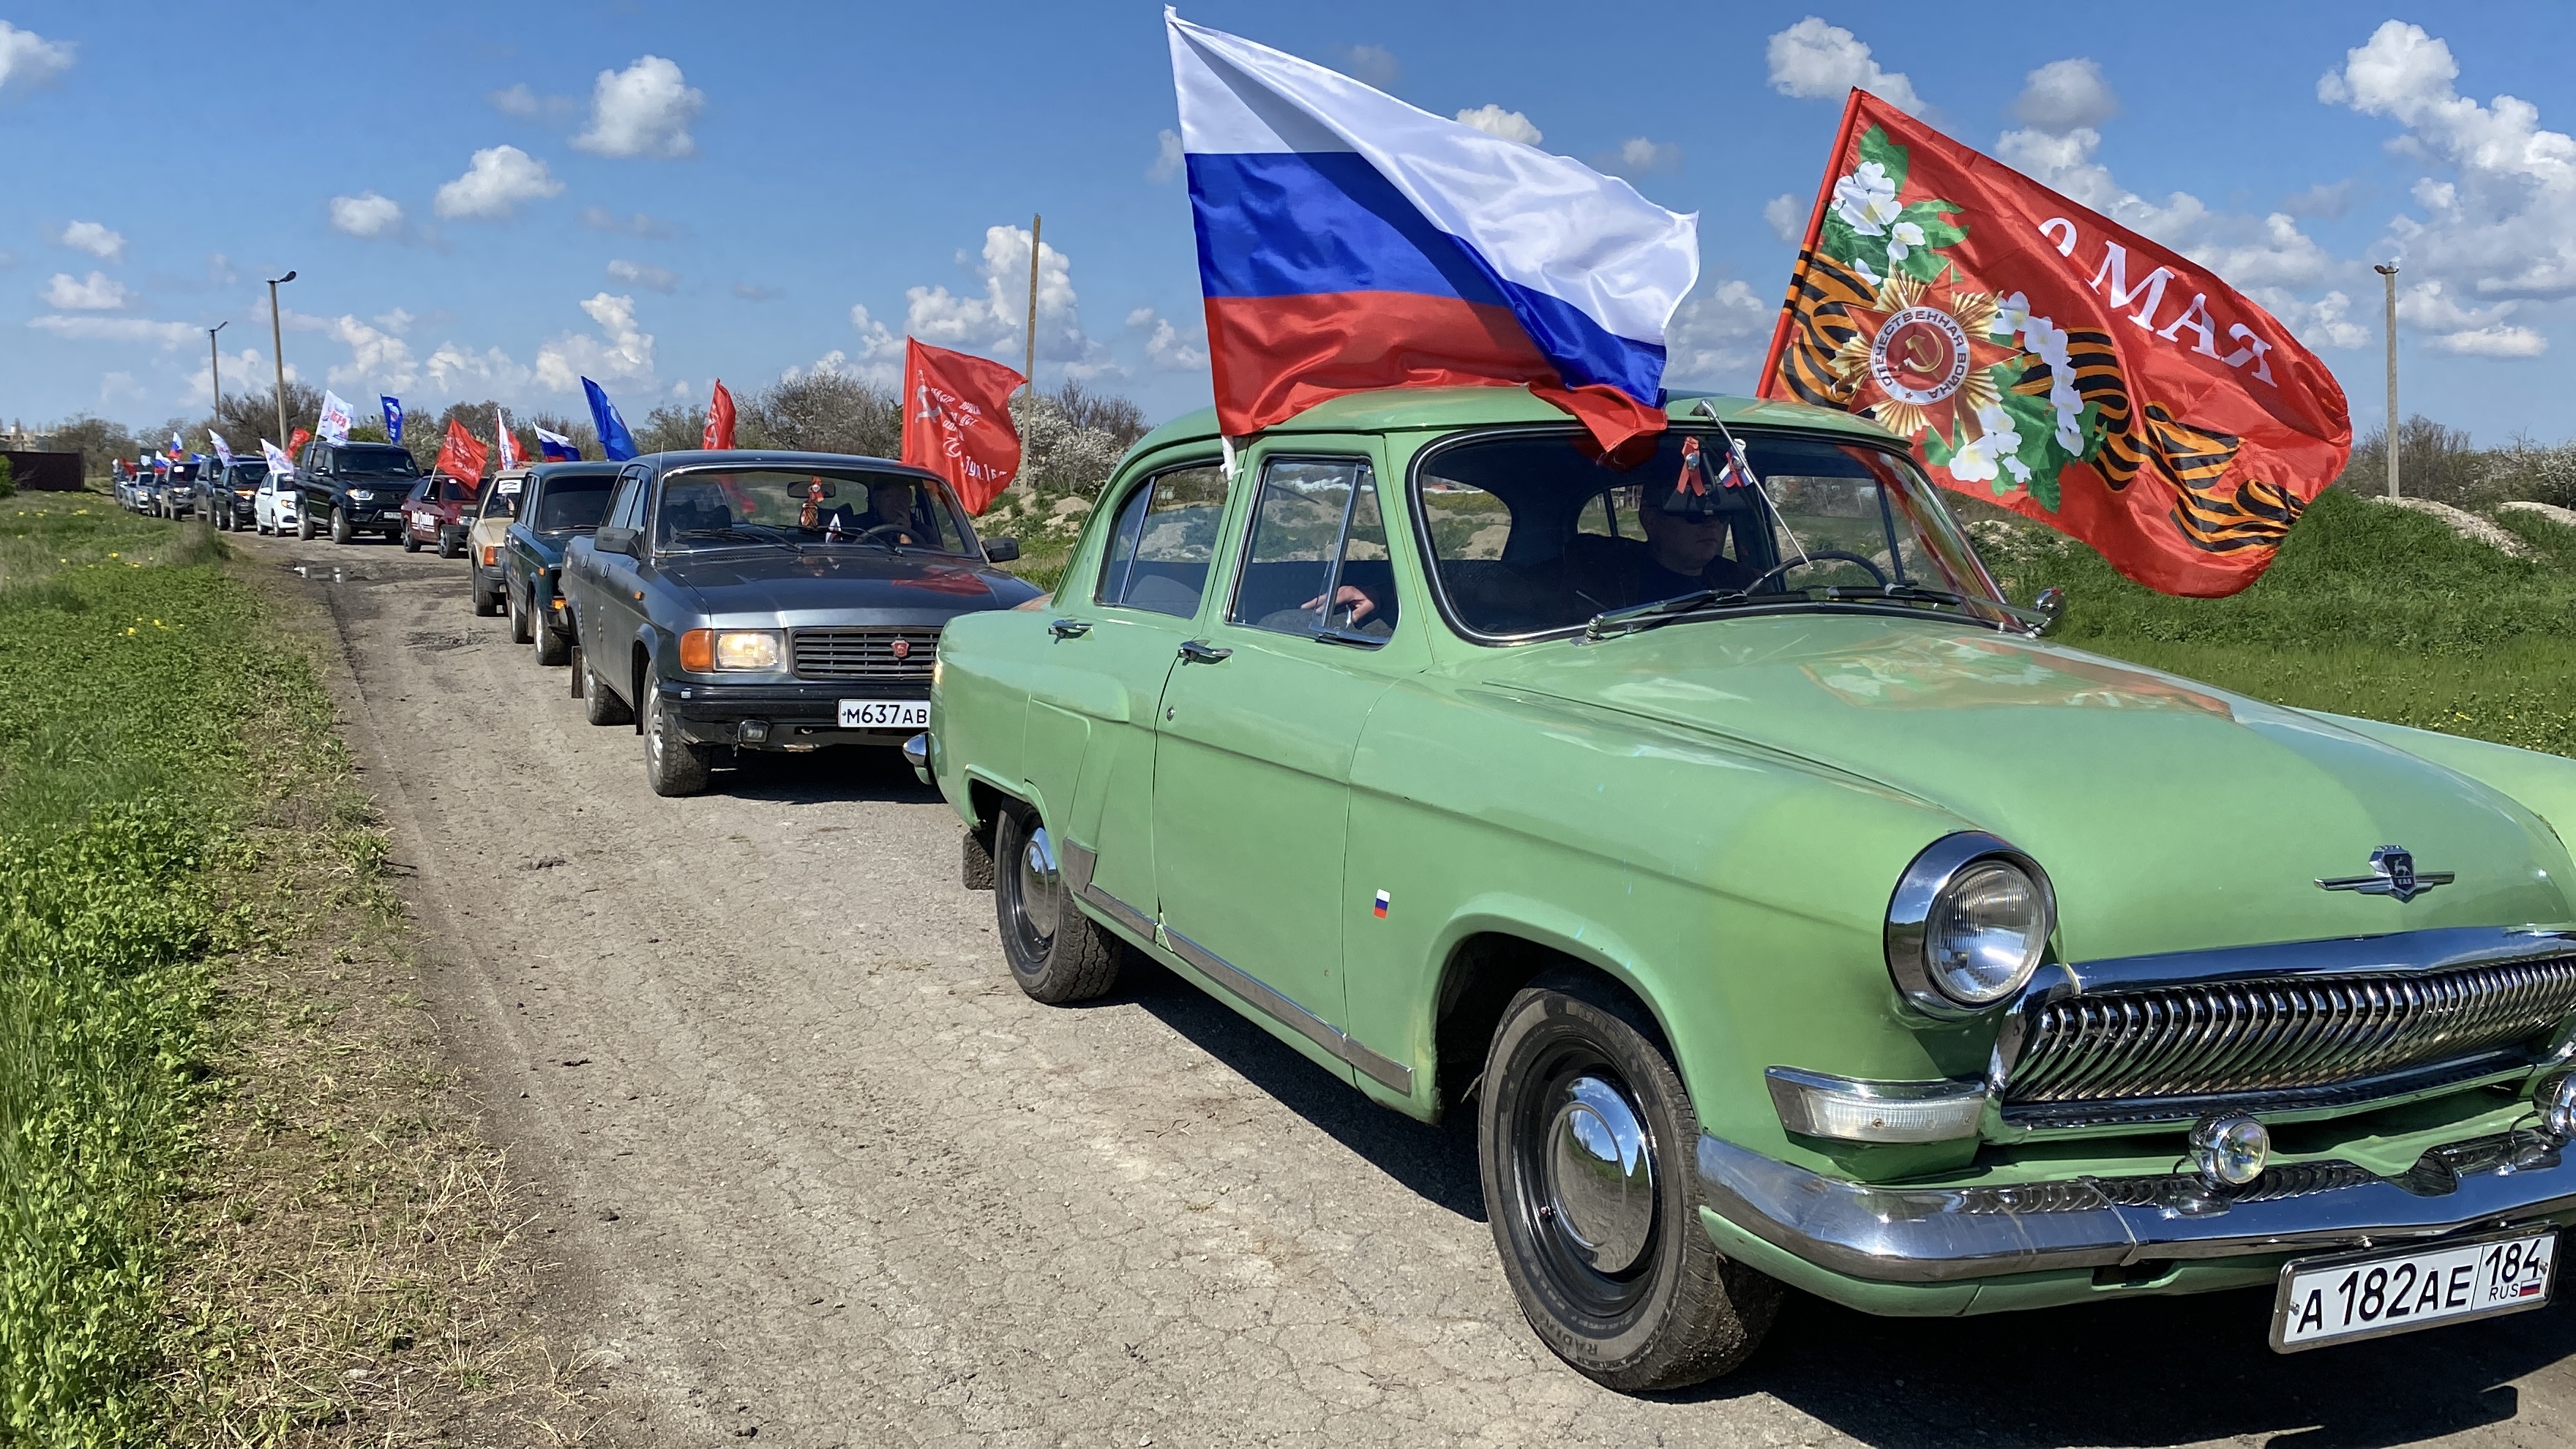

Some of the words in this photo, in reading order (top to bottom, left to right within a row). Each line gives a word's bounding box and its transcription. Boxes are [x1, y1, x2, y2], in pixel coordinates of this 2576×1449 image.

[2084, 240, 2278, 388] МАЯ
[1875, 310, 1966, 387] ОТЕЧЕСТВЕННАЯ
[847, 704, 927, 724] М637АВ
[2485, 1238, 2542, 1287] 184
[2488, 1281, 2520, 1303] RUS
